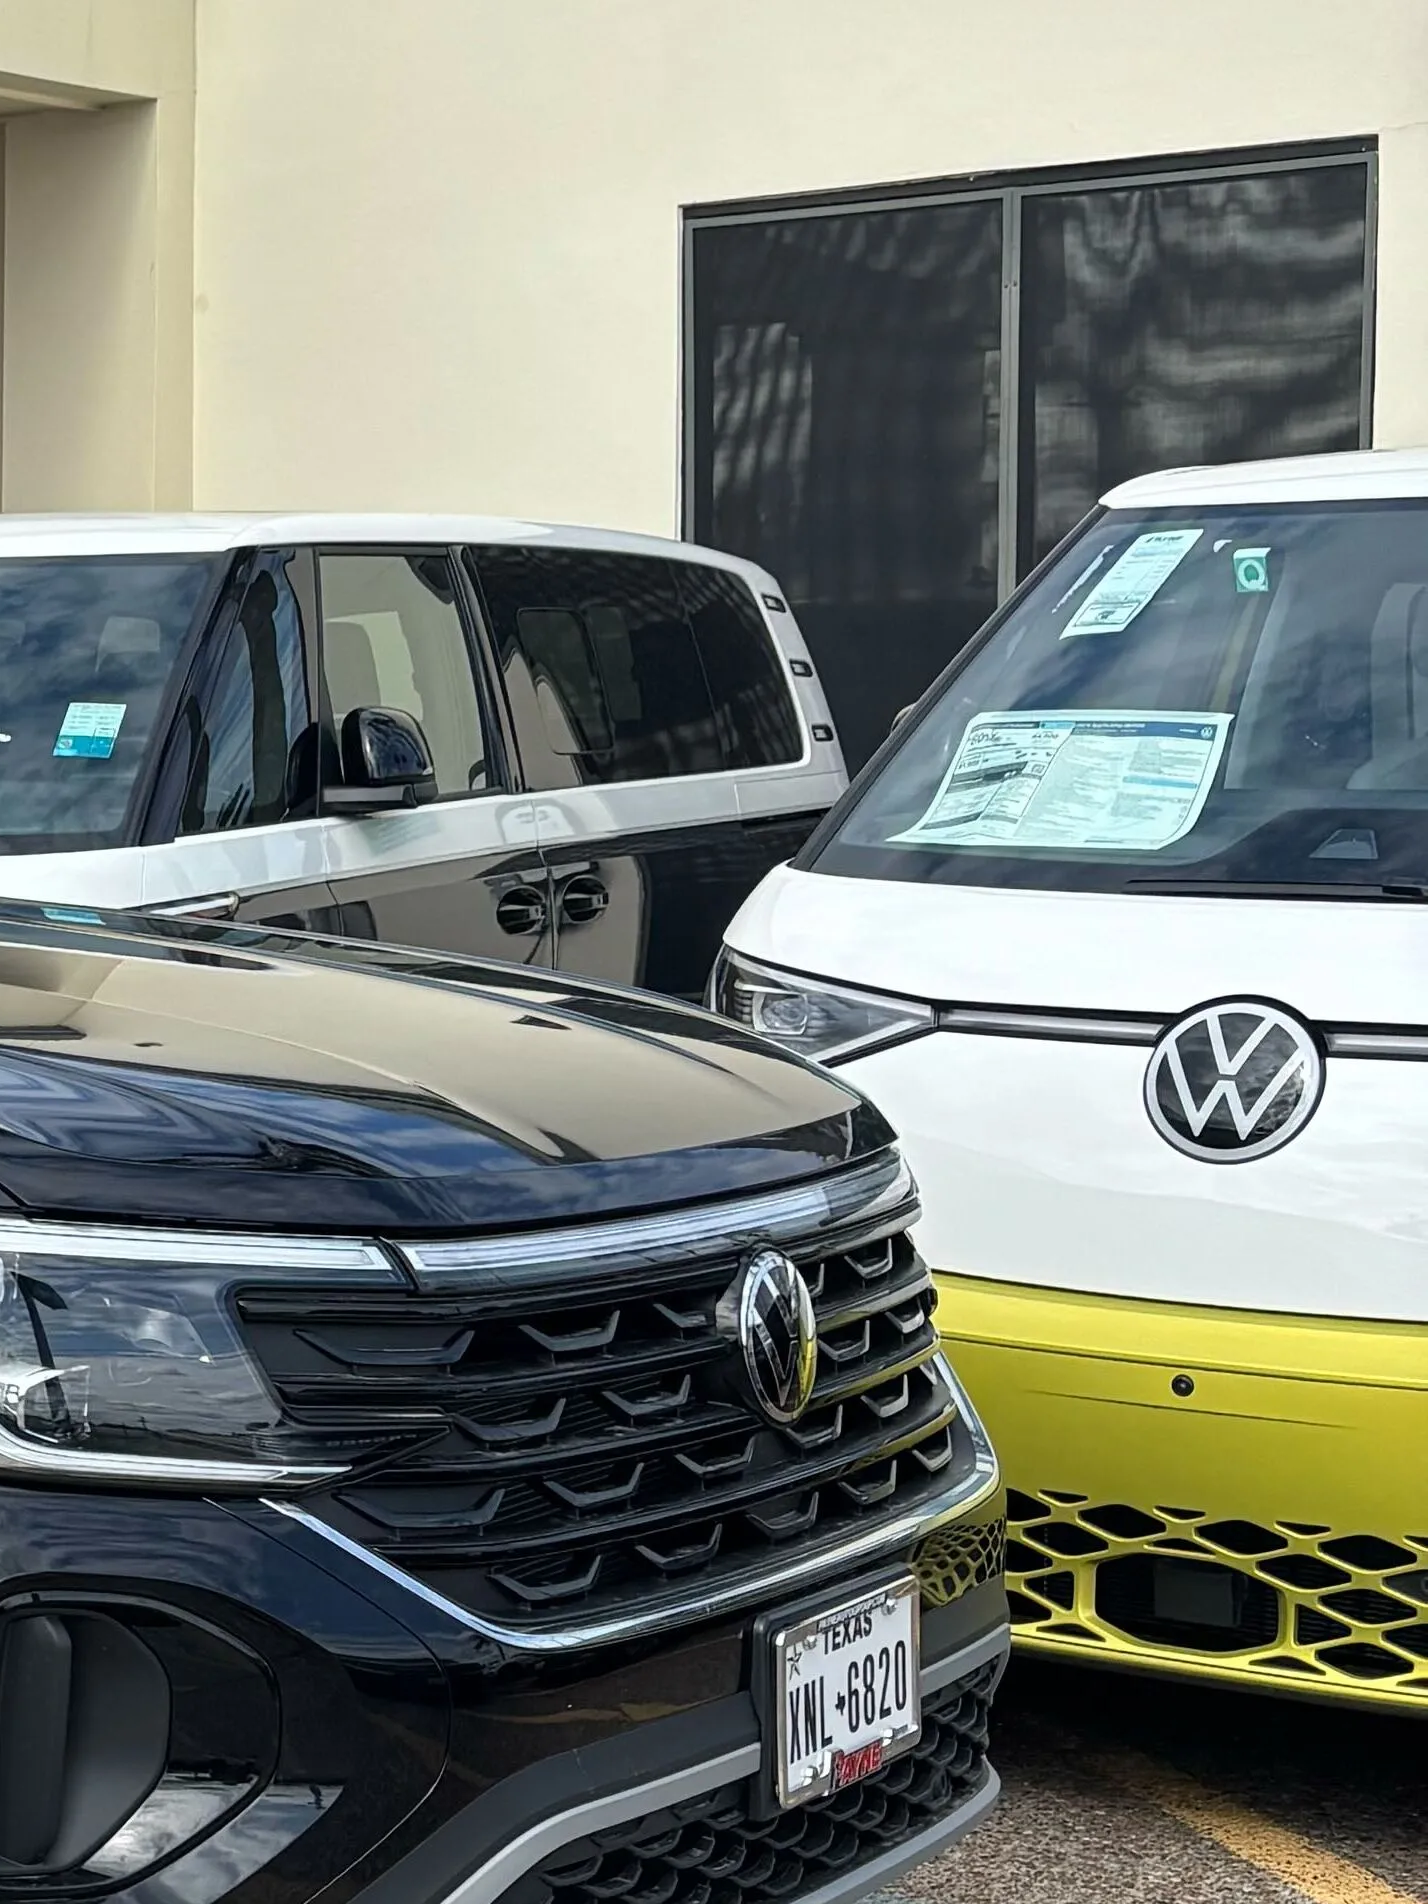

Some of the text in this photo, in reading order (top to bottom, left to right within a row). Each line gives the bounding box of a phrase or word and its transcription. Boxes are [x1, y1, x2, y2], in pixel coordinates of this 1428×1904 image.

[1154, 1003, 1321, 1153] VW
[823, 1612, 873, 1655] TEXAS
[788, 1640, 907, 1764] XNL 6820
[835, 1740, 883, 1788] PAYNE
